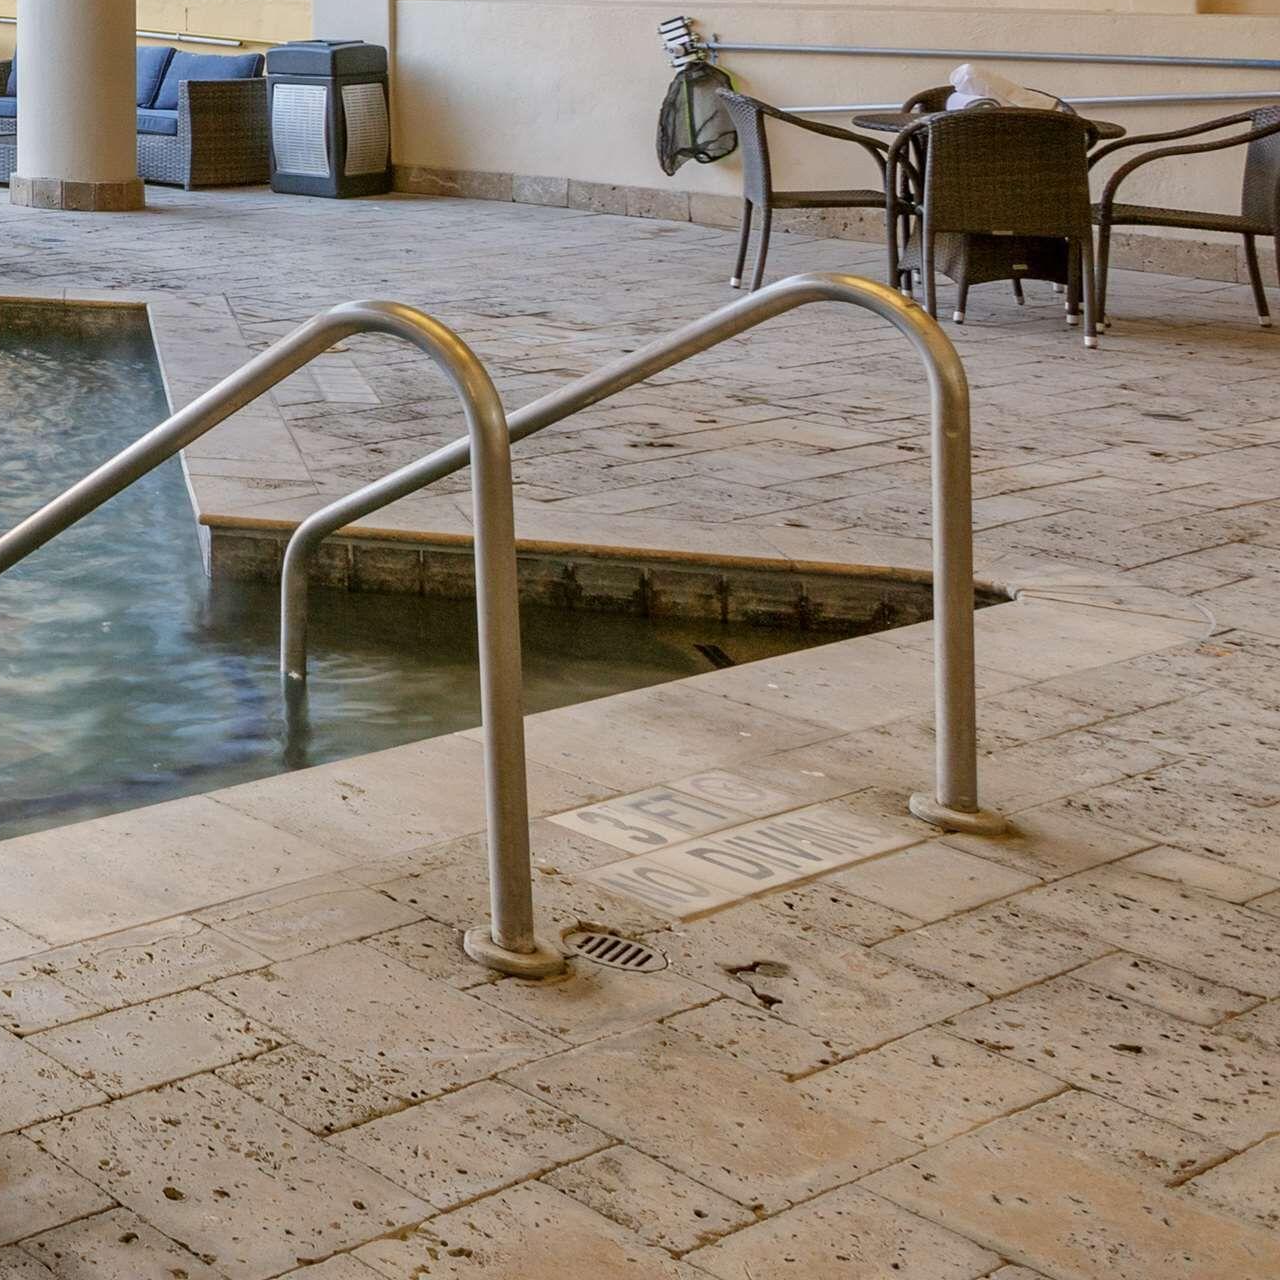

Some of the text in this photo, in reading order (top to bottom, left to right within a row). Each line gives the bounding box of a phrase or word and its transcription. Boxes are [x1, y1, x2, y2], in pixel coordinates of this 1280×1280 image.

[576, 792, 730, 846] 3 FT
[596, 811, 894, 910] NO DIVING
